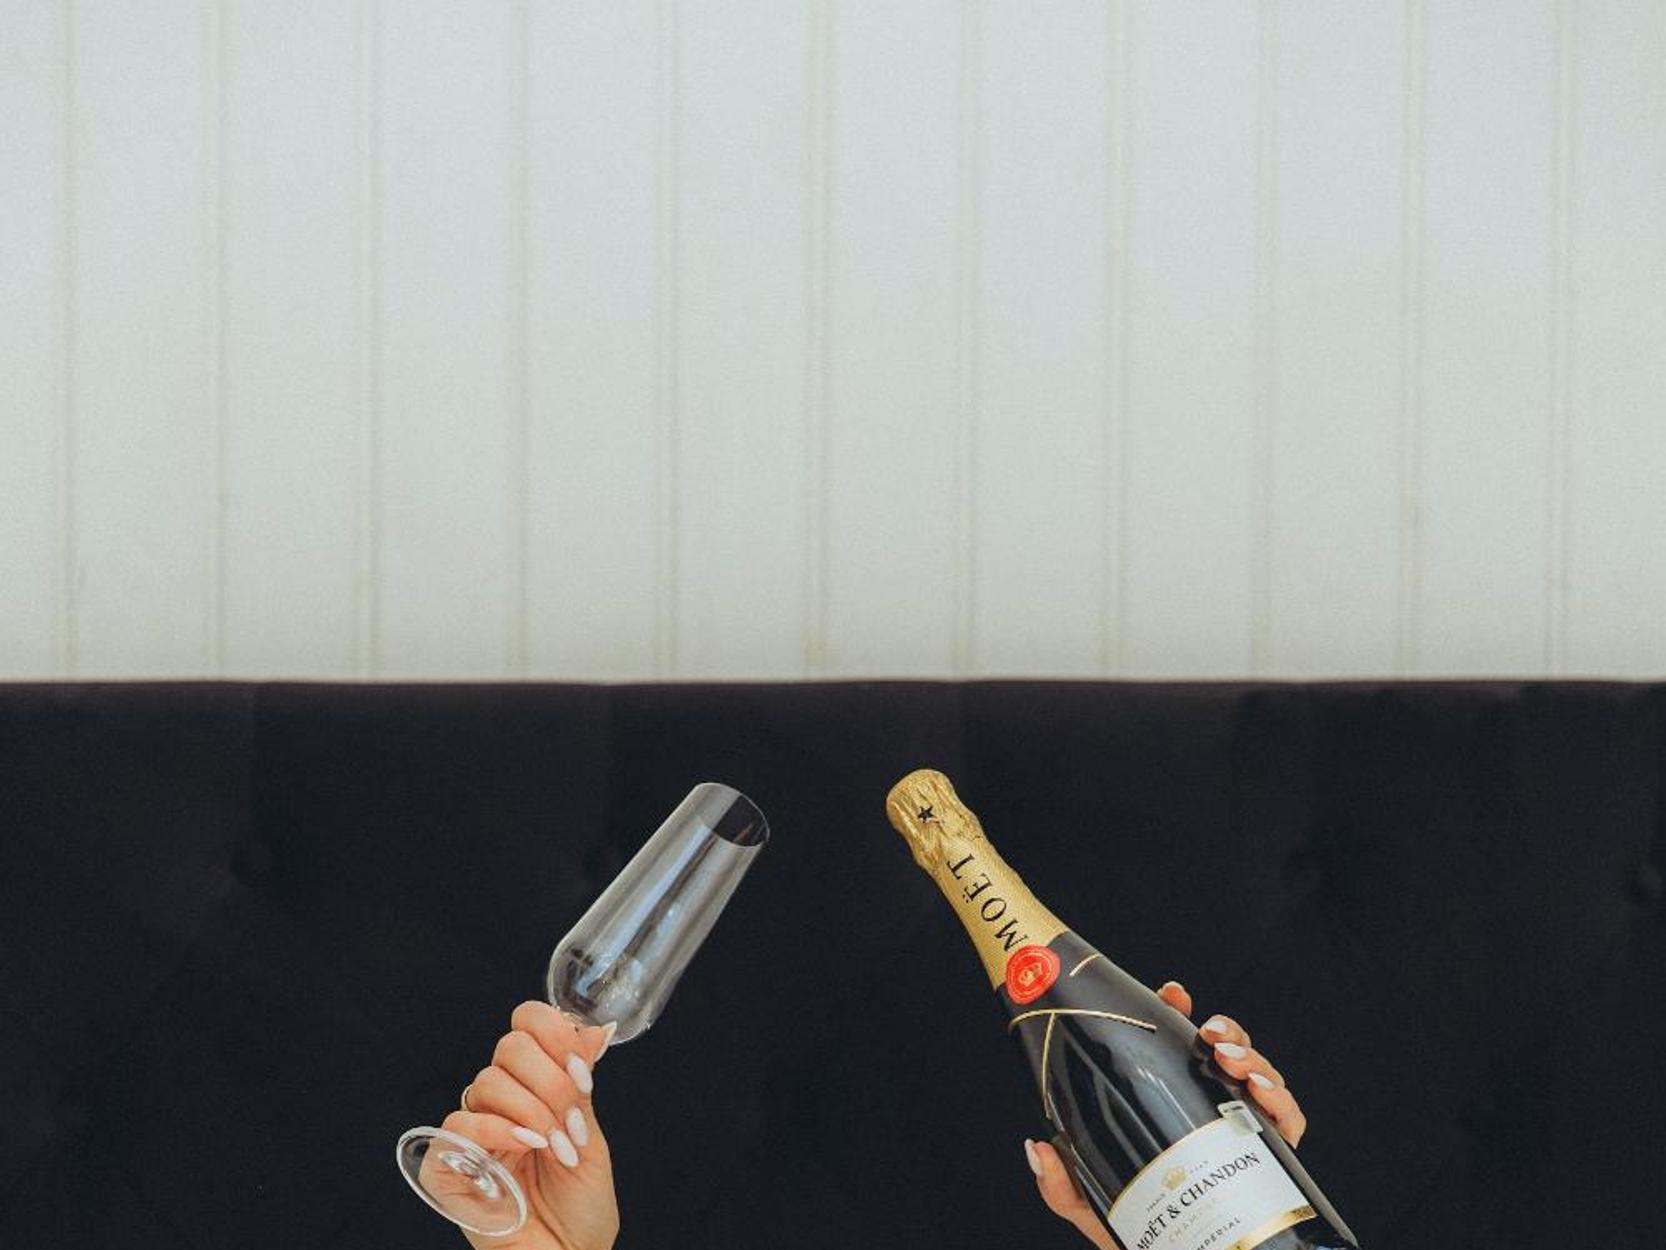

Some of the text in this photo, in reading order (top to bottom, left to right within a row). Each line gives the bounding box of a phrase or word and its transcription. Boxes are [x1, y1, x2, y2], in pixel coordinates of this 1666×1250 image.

[946, 854, 1028, 951] MOËT
[1137, 1214, 1167, 1250] MOËT
[1167, 1205, 1181, 1218] &
[1180, 1152, 1261, 1206] CHANDON
